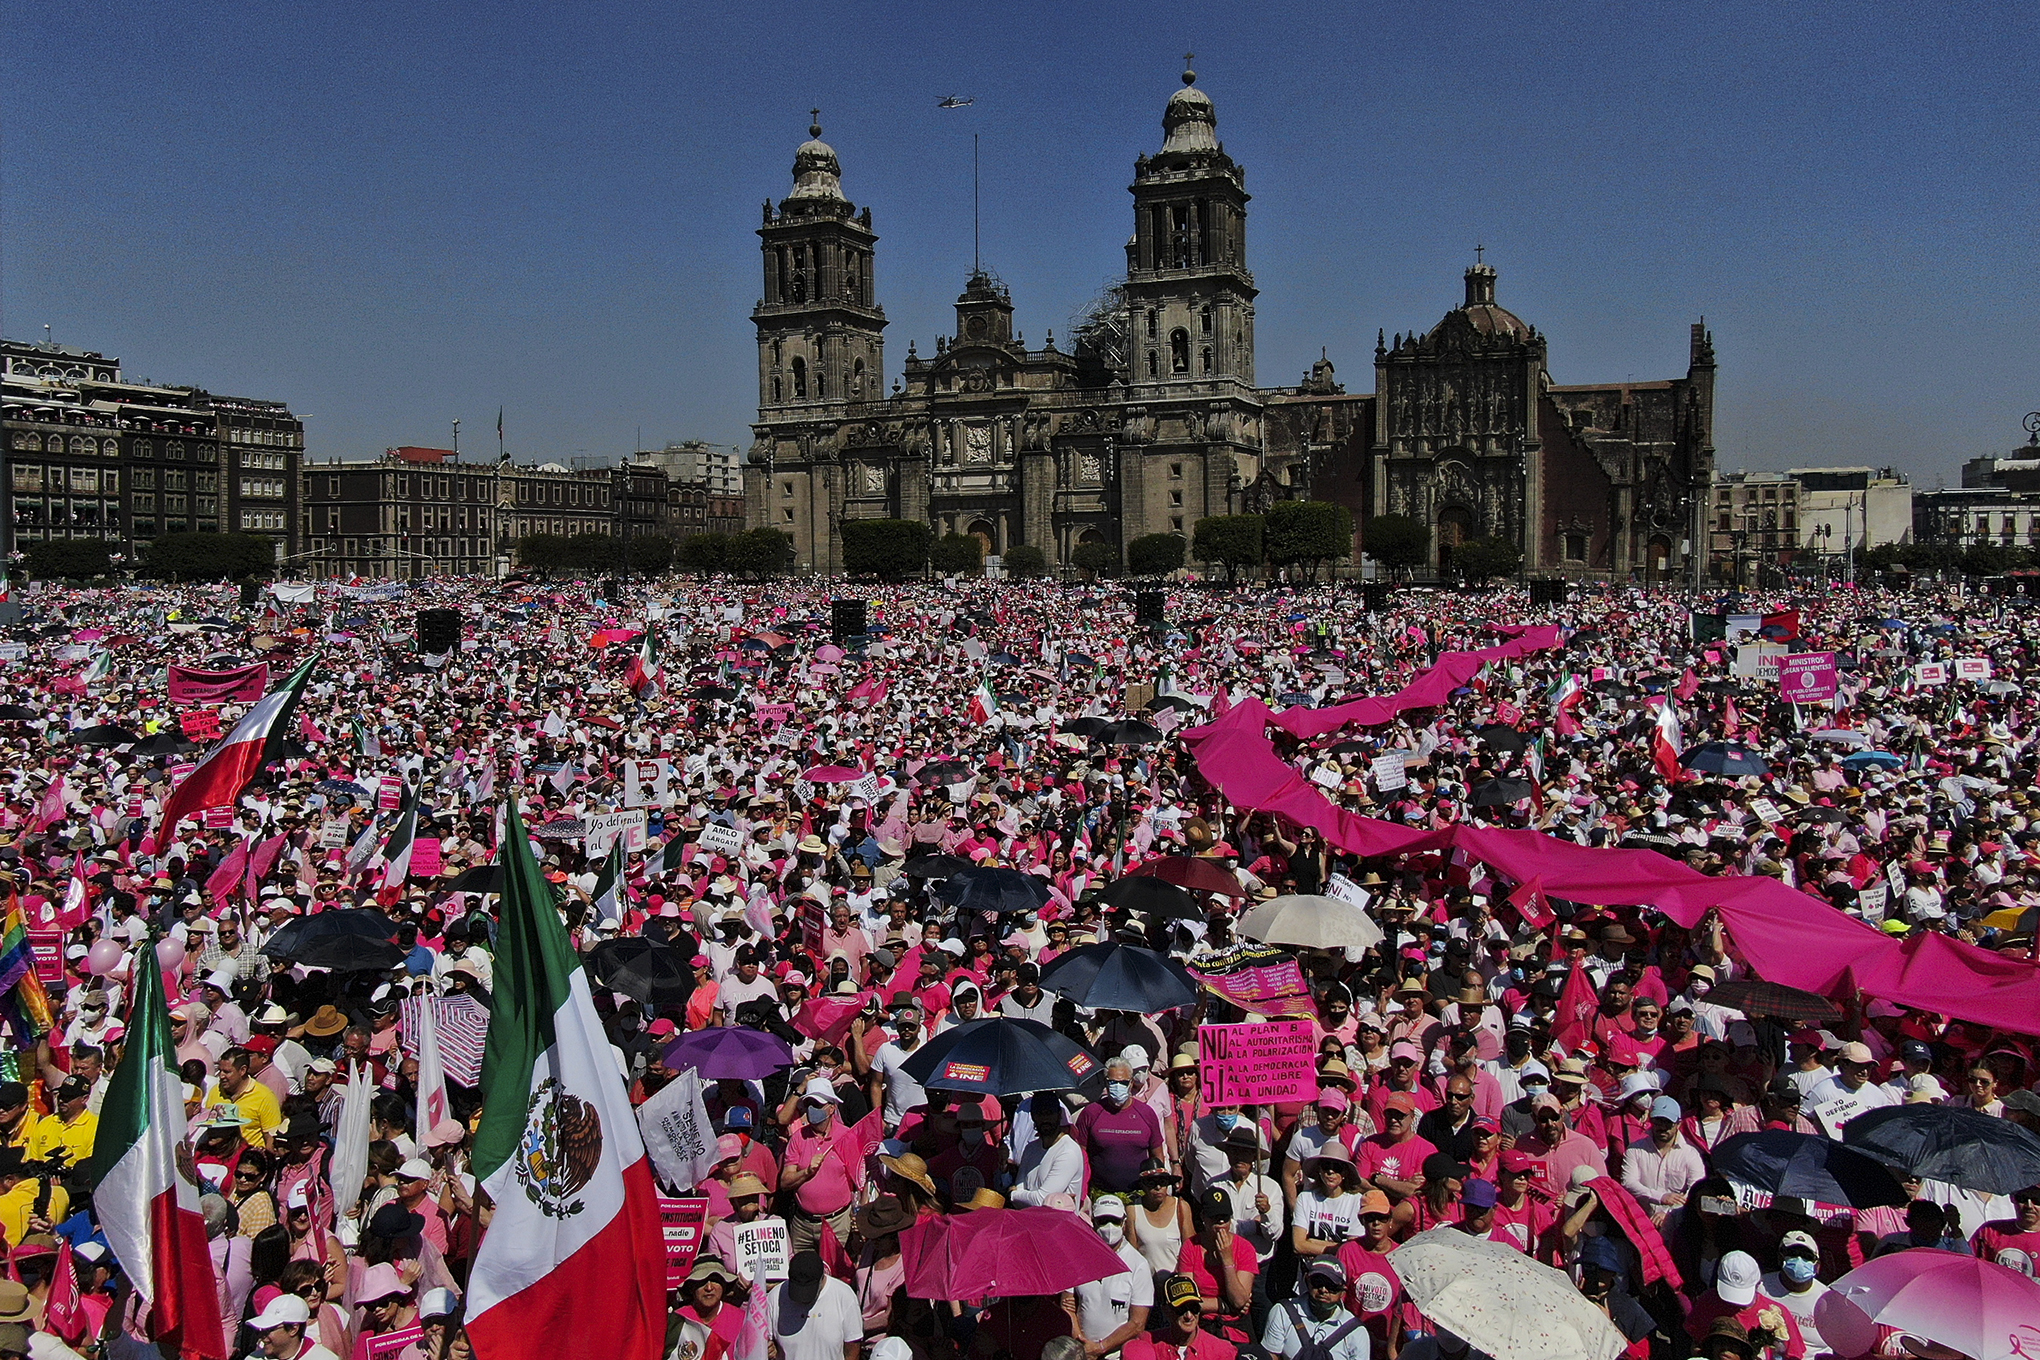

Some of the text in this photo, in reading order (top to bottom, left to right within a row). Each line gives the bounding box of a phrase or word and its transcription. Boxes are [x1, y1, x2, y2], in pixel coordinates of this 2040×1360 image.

[1789, 656, 1825, 666] MINISTROS
[606, 813, 643, 827] defiendo
[606, 826, 642, 850] IE
[712, 826, 737, 838] AMLO
[590, 836, 603, 851] al
[1212, 957, 1233, 967] contra
[1233, 953, 1241, 962] la
[1241, 949, 1282, 958] democracia
[1201, 1024, 1298, 1061] NO AL PLAN B
[1228, 1035, 1313, 1047] AL AUTORITARISMO
[1227, 1051, 1233, 1059] A
[1237, 1050, 1248, 1059] LA
[1227, 1065, 1234, 1073] A
[1238, 1065, 1249, 1073] LA
[1253, 1060, 1310, 1072] DEMOCRACIA
[959, 1073, 984, 1081] INE
[1227, 1071, 1302, 1083] AL VOTO LIBRE
[1226, 1084, 1298, 1098] A LA UNIDAD
[1825, 1101, 1858, 1117] DEFIENDO
[660, 1211, 703, 1223] ONSTITUCIÓN
[1318, 1212, 1334, 1221] INE
[1335, 1215, 1351, 1224] nos
[738, 1226, 785, 1245] #ELINENO
[744, 1240, 781, 1256] SETOCA
[387, 1336, 410, 1346] ENCIMA
